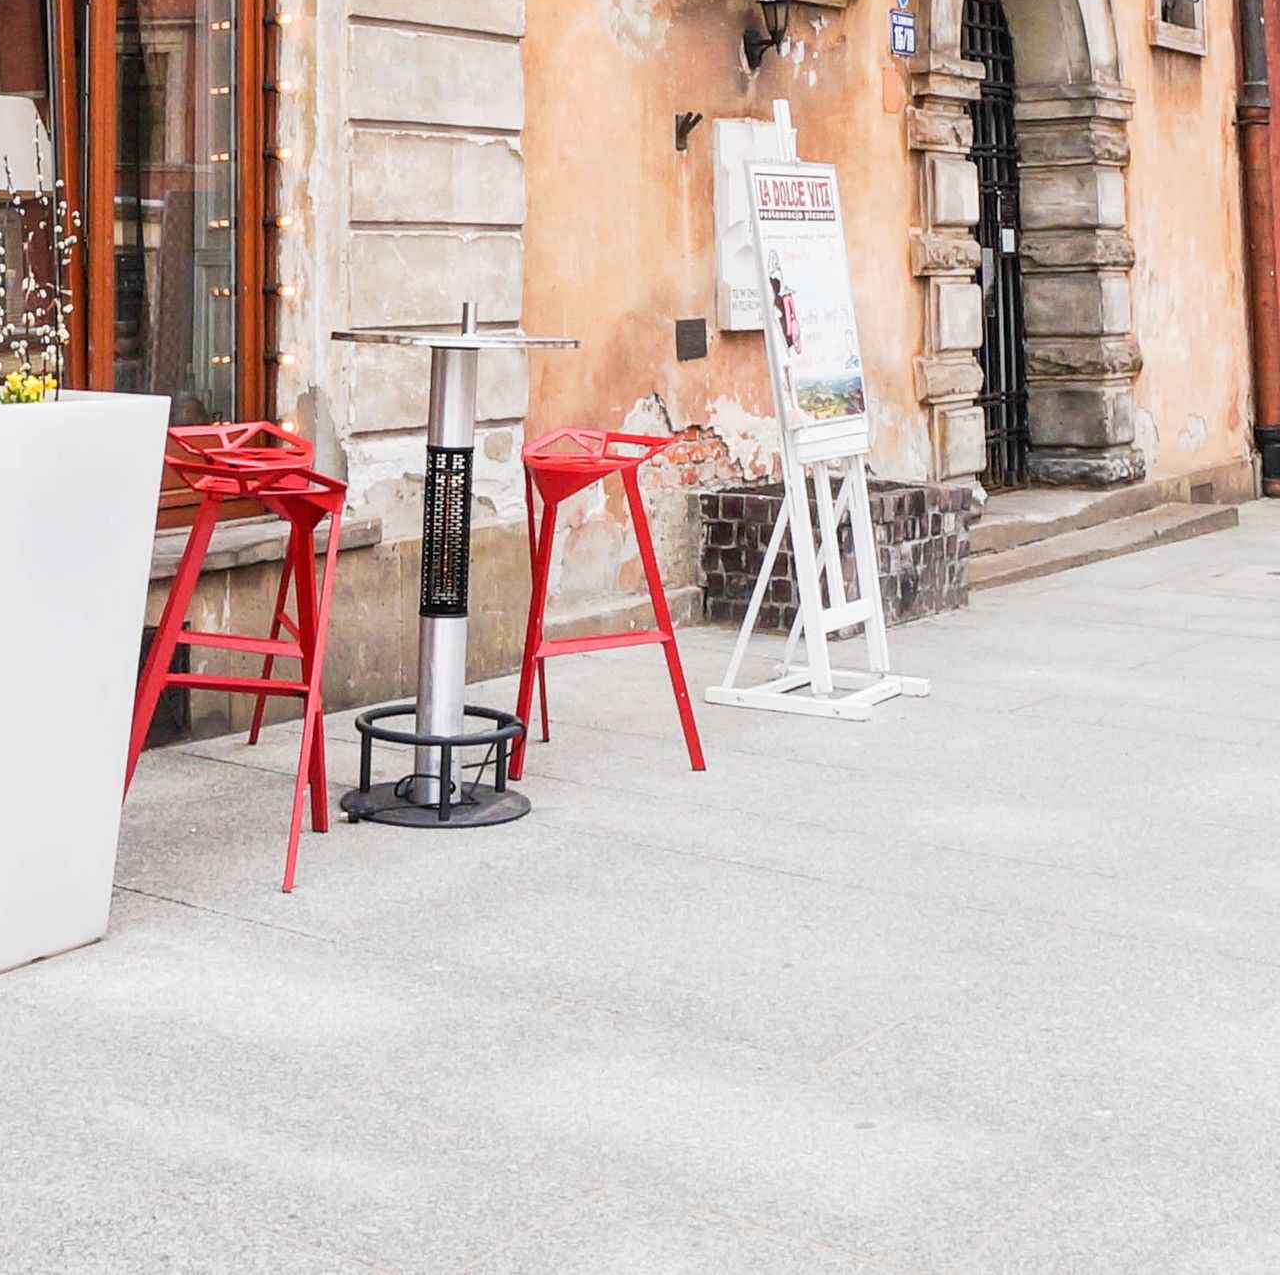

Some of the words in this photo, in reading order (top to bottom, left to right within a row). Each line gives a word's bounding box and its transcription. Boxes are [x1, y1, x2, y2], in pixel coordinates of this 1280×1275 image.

[759, 179, 771, 206] LA
[772, 180, 806, 207] DOLCE
[807, 181, 831, 208] VITA
